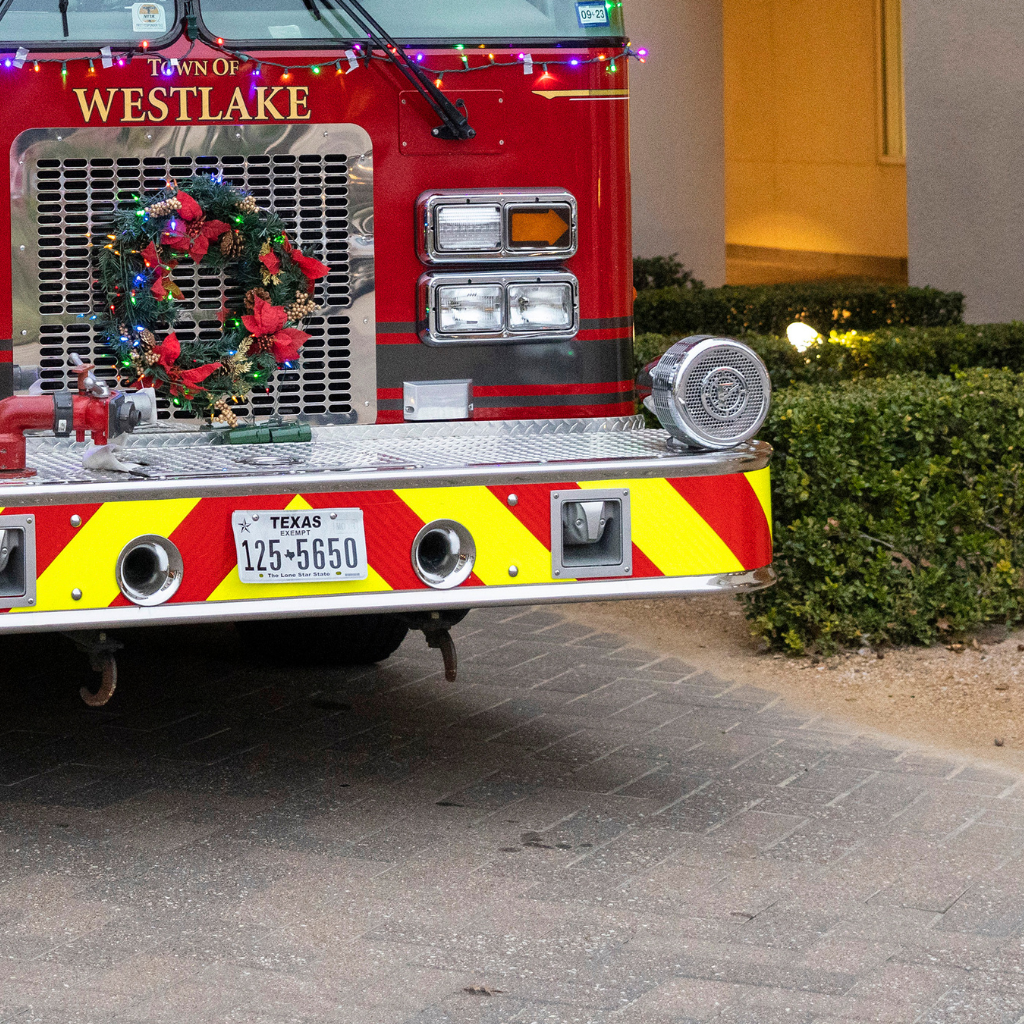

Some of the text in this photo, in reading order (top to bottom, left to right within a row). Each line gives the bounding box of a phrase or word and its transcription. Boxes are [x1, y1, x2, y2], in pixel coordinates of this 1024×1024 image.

[147, 57, 240, 76] TOWN OF
[73, 86, 312, 123] WESTLAKE
[270, 516, 322, 529] TEXAS
